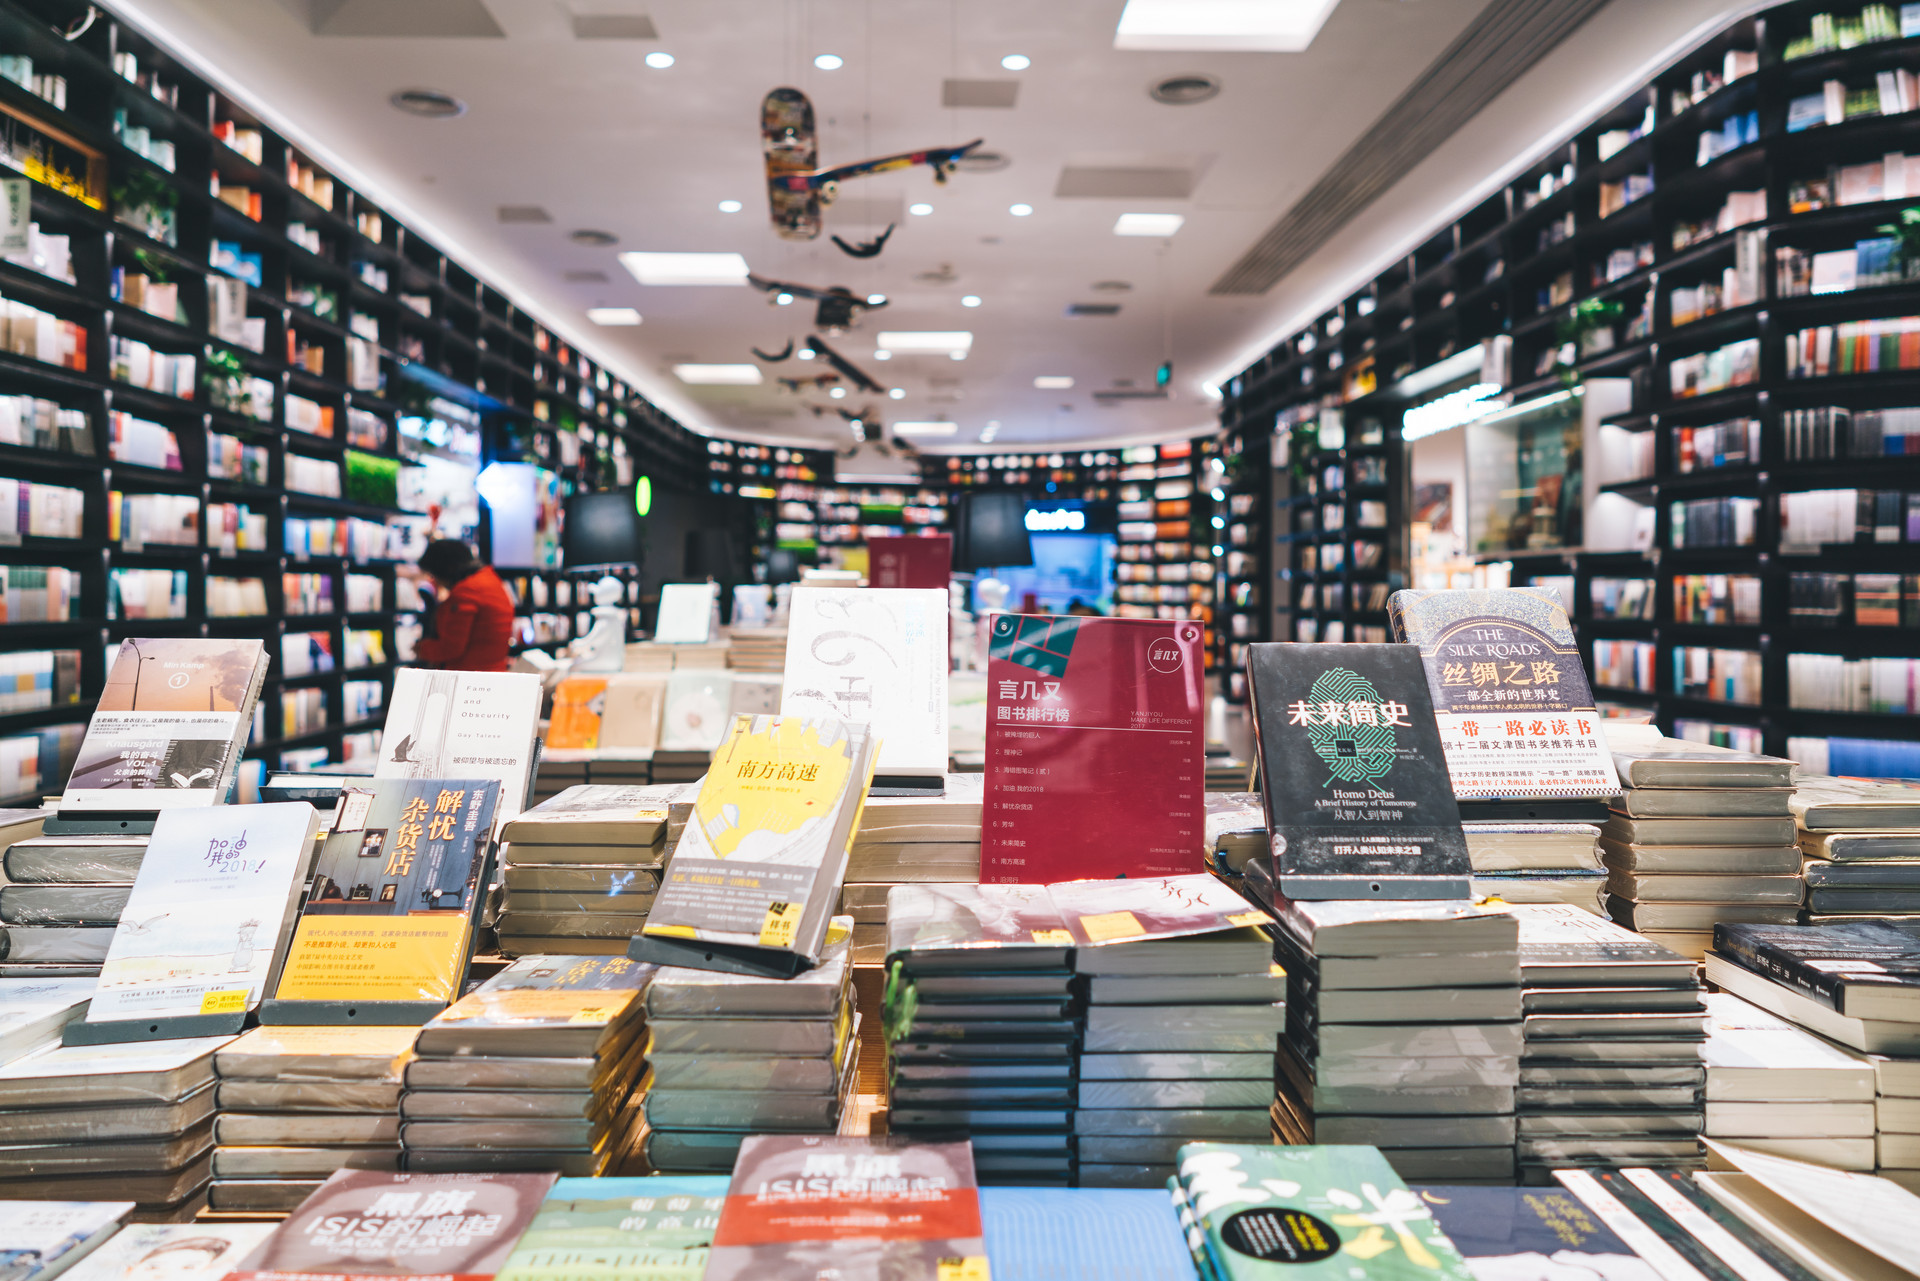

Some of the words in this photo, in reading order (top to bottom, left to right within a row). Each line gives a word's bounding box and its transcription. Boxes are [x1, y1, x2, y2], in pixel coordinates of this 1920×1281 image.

[1473, 630, 1505, 641] THE
[1448, 644, 1480, 657] SILK
[1488, 644, 1540, 659] ROADS
[180, 662, 204, 670] Kamp
[1442, 660, 1562, 687] 丝绸之路
[998, 680, 1062, 701] 言几又
[1453, 688, 1560, 702] 一部全新的世界史
[461, 712, 510, 720] Obscurity
[997, 706, 1070, 722] 图书排行榜
[1288, 700, 1412, 727] 未来简史
[1440, 719, 1592, 737] 一带一路必读书
[106, 740, 164, 748] Knausgård
[1443, 739, 1598, 750] 第十二届文津图书奖推荐书目
[120, 751, 158, 759] 我的奋斗
[453, 756, 516, 766] 被仰望与被遗忘的
[737, 760, 821, 781] 南方高速
[1333, 790, 1366, 799] Homo
[1368, 790, 1395, 799] Deus
[427, 789, 466, 841] 解忧
[464, 789, 485, 832] 东野圭吾
[1334, 810, 1403, 821] 从智人到智神
[384, 796, 430, 876] 杂货店
[219, 860, 266, 873] 2018!
